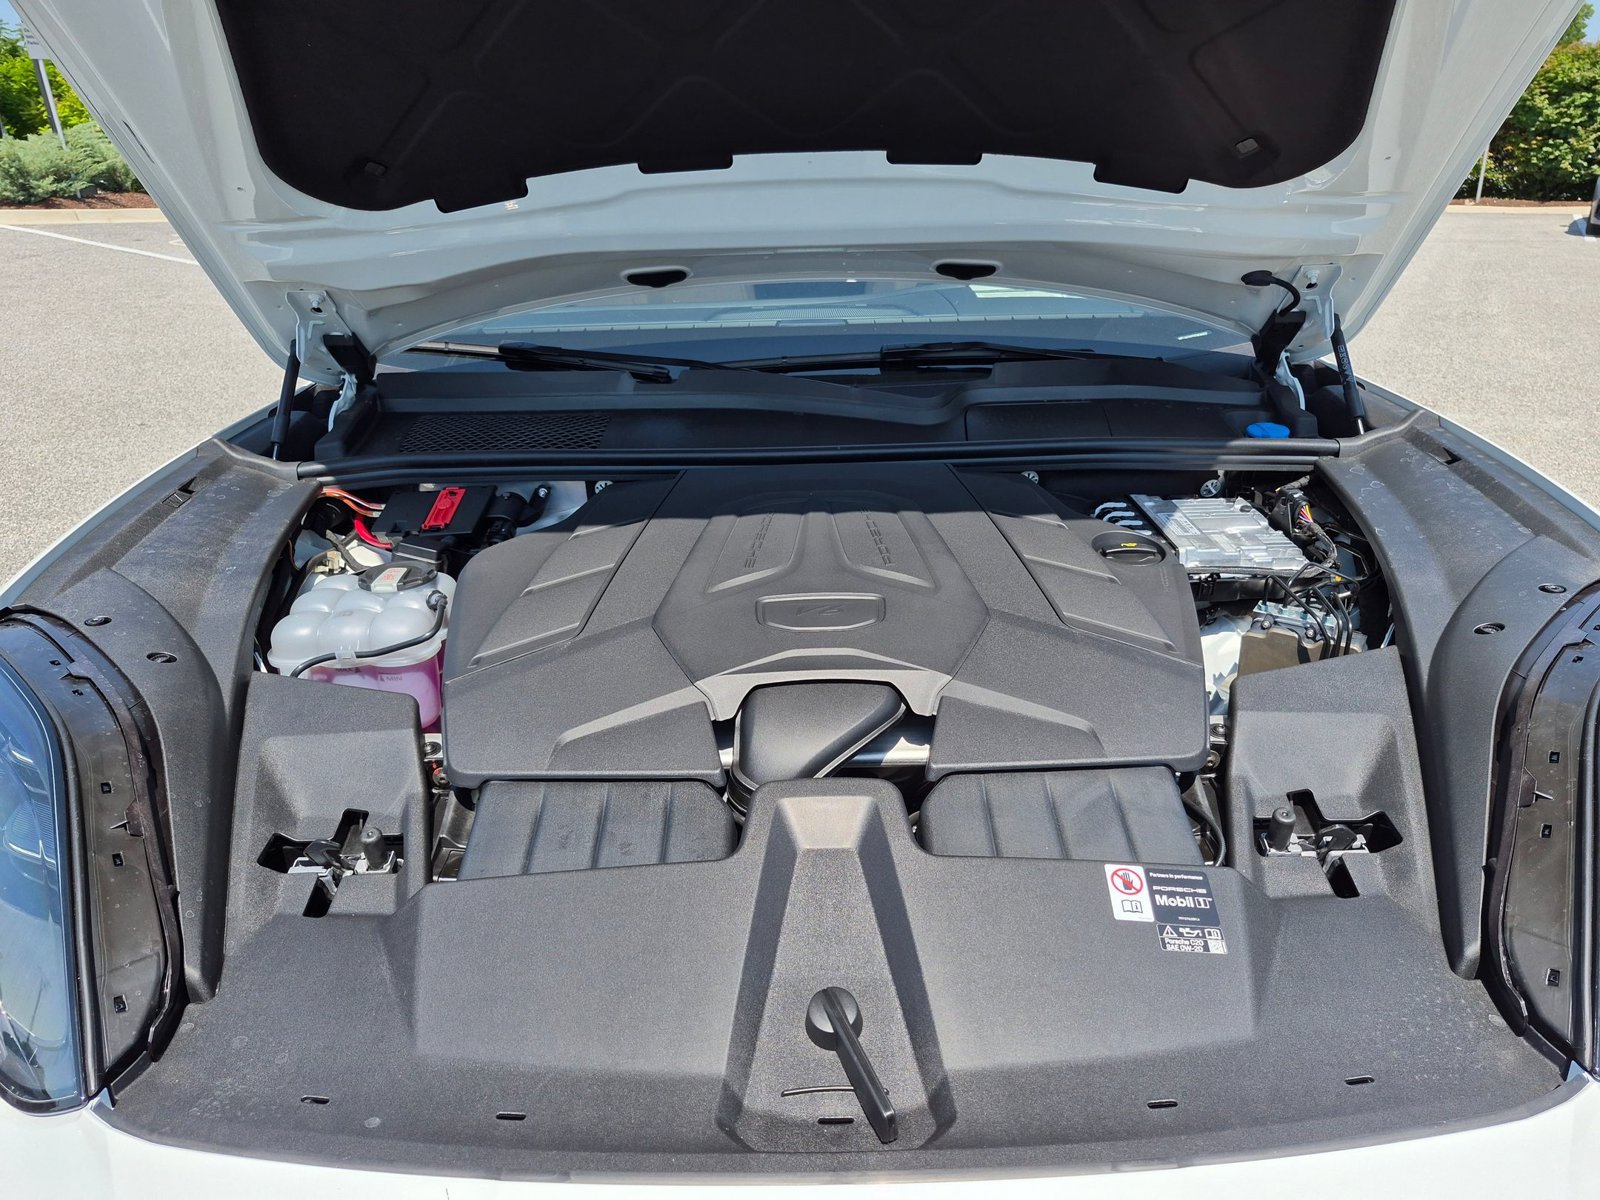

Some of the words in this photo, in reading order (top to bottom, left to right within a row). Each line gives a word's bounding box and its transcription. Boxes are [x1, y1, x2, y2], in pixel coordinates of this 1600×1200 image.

[859, 509, 895, 566] PORSCH
[1153, 886, 1207, 894] PORSCHE
[1155, 895, 1194, 908] Mobil
